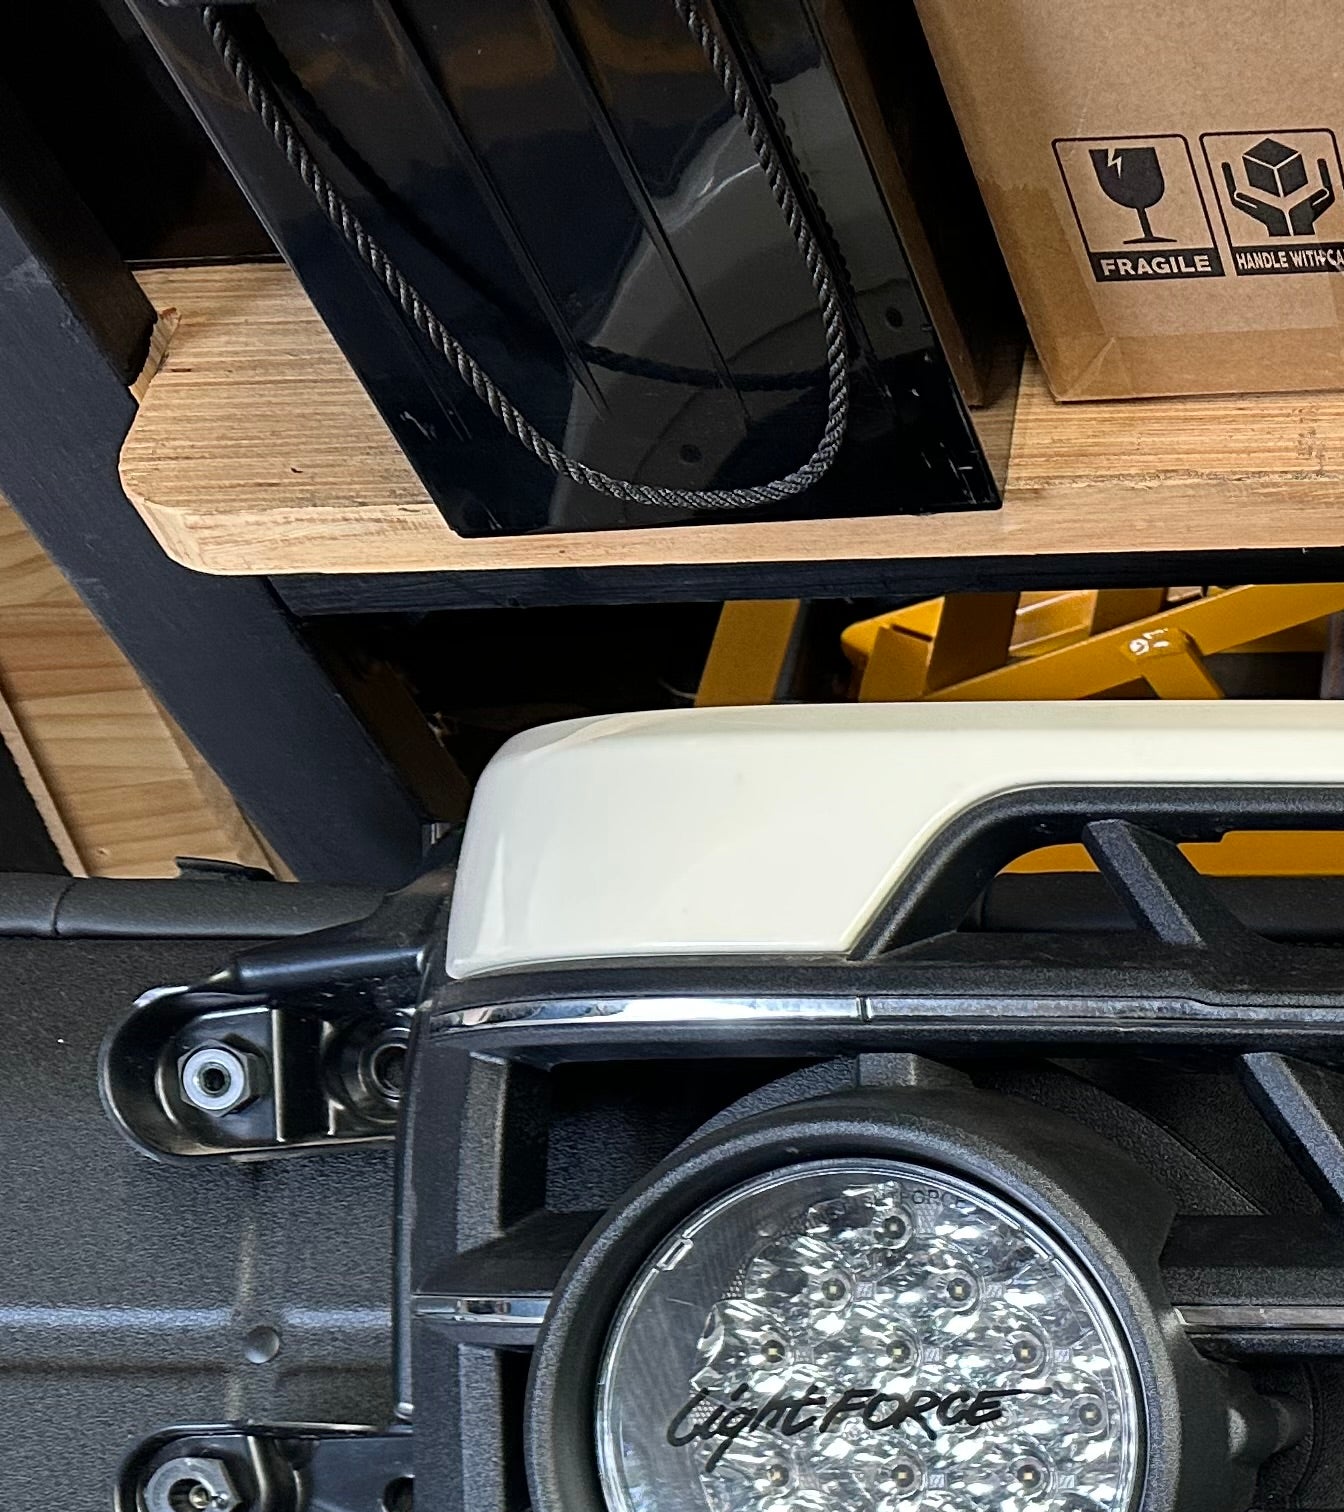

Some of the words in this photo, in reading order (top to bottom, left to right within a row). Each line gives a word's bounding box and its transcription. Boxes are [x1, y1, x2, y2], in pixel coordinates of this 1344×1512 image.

[1100, 254, 1212, 277] FRAGILE
[1235, 251, 1289, 270] HANDLE
[1290, 249, 1326, 268] WITH
